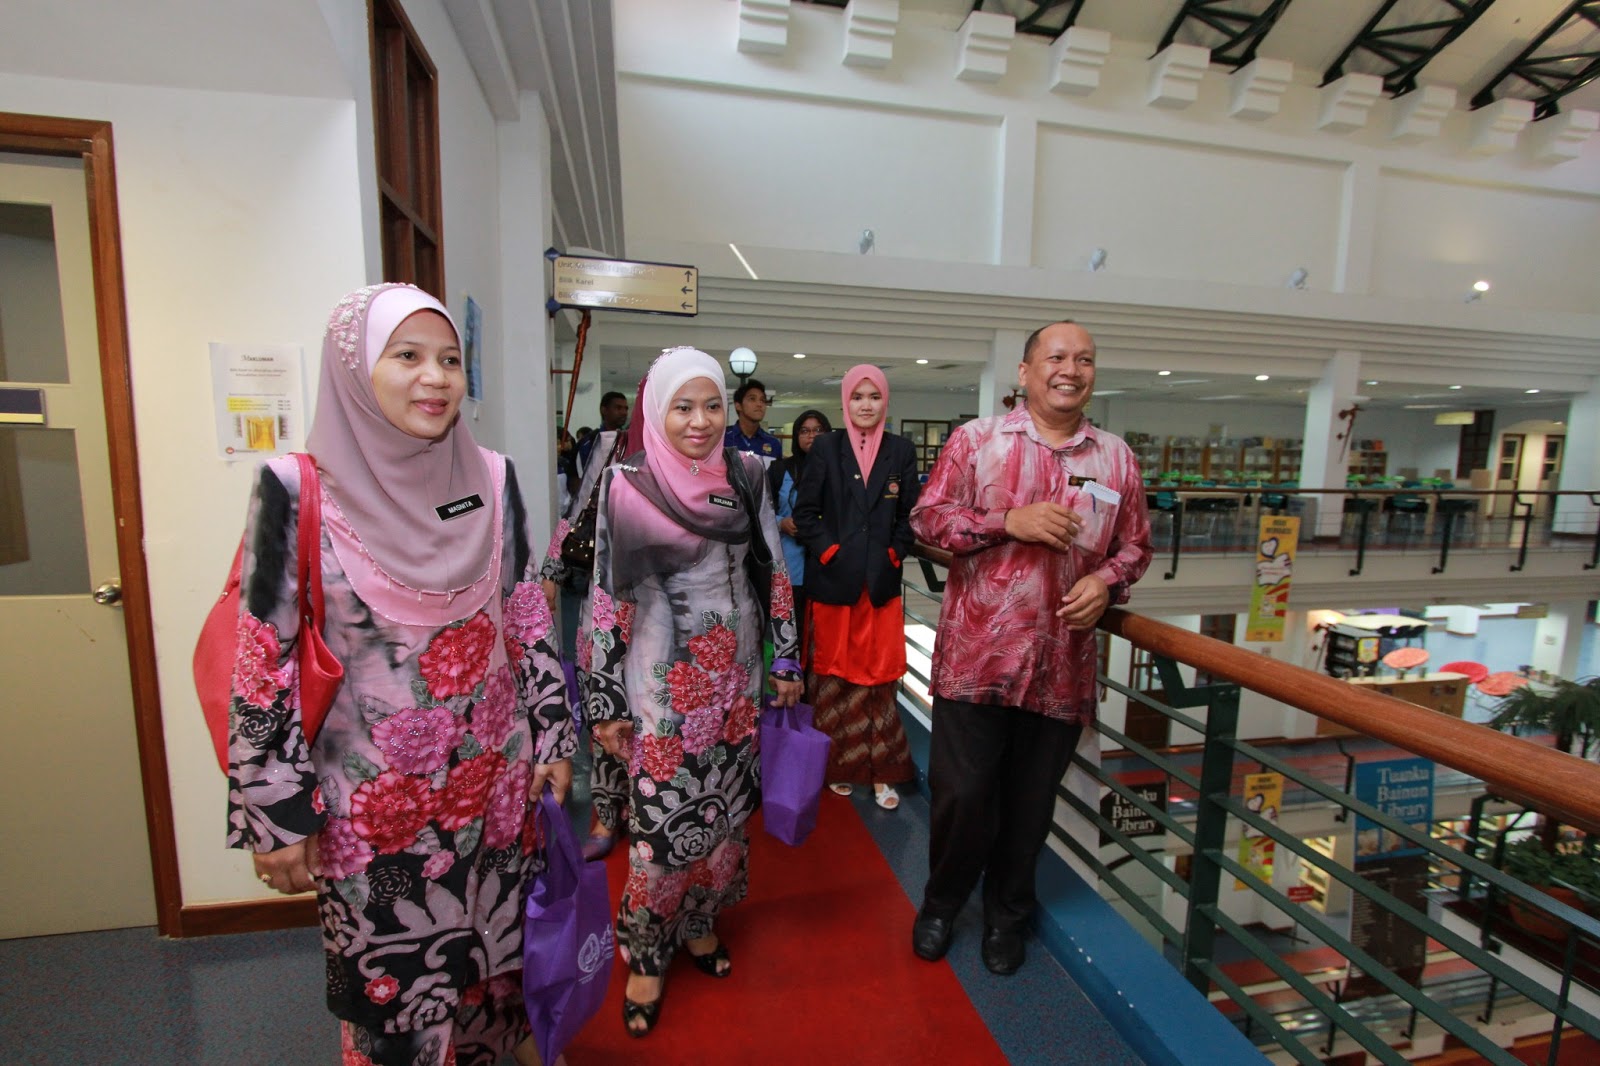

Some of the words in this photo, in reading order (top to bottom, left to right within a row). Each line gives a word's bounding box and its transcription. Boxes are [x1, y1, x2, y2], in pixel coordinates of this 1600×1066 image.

[1376, 766, 1429, 784] Tuanku
[1111, 789, 1158, 805] Tuku
[1377, 785, 1429, 802] Bainun
[1112, 805, 1147, 819] Bain
